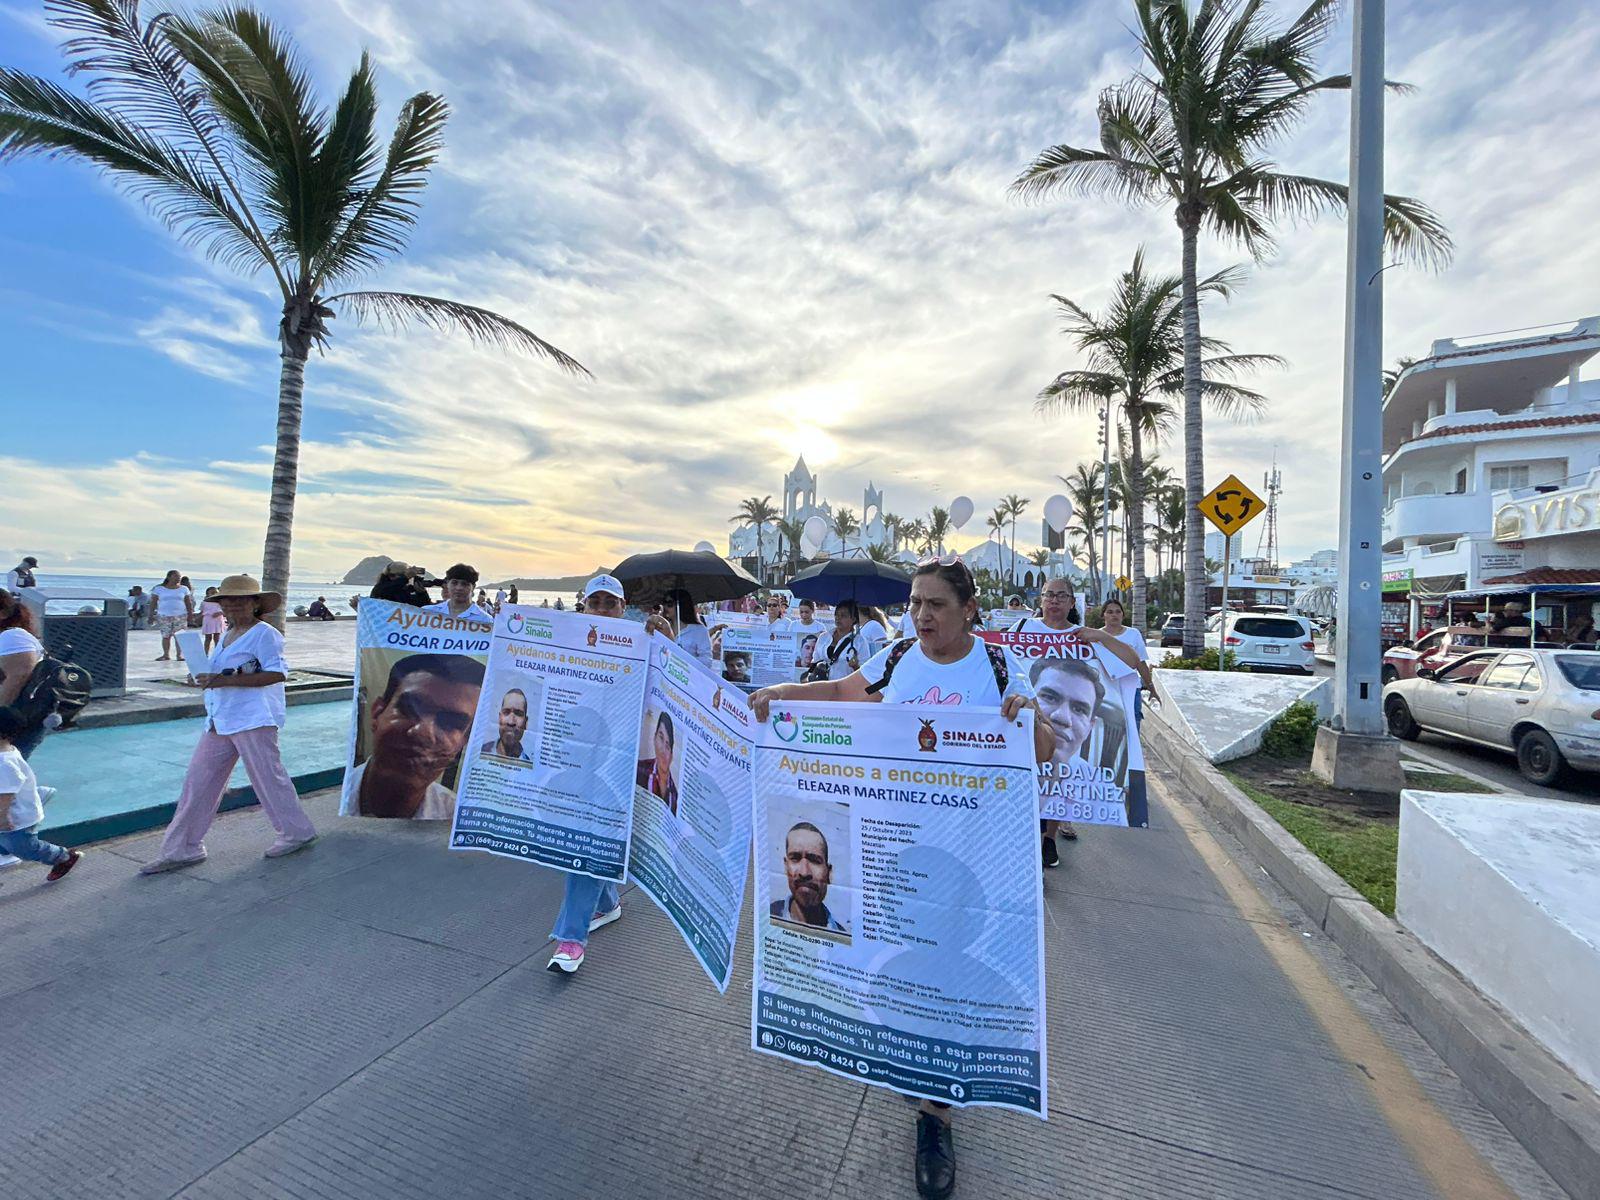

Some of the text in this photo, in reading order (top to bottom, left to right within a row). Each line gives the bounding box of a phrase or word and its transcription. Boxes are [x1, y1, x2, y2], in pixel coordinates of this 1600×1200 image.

[387, 607, 492, 633] Ayúdanos
[387, 632, 490, 651] OSCAR DAVID
[525, 626, 552, 639] Sinaloa
[600, 633, 633, 644] SINALOA
[1000, 633, 1082, 644] TE ESTAMO
[507, 643, 631, 673] Ayúdanos a encontrar a
[515, 660, 614, 684] ELEAZAR MARTINEZ CASAS
[721, 698, 748, 724] SINALOA
[802, 730, 852, 746] Sinaloa
[942, 730, 1006, 743] SINALOA
[779, 755, 1007, 790] Ayúdanos a encontrar a
[1059, 763, 1115, 783] DAVID
[797, 779, 978, 809] ELEAZAR MARTINEZ CASAS
[1038, 780, 1124, 802] MARTINEZ
[1045, 801, 1120, 821] 46 68 04
[460, 818, 480, 827] llama
[527, 830, 535, 838] Tu
[566, 841, 581, 850] muy
[472, 810, 494, 819] tienes
[537, 825, 565, 837] referente
[575, 834, 590, 842] esta
[592, 839, 622, 851] persona,
[861, 833, 887, 841] Municipio
[504, 843, 519, 851] 8424
[877, 850, 898, 858] Hombre
[762, 1008, 789, 1024] llama
[791, 1018, 797, 1026] o
[862, 1038, 875, 1050] Tu
[878, 1044, 912, 1061] ayuda
[915, 1055, 929, 1064] es
[932, 1057, 959, 1072] muy
[962, 1063, 1034, 1078] importante.
[777, 1000, 806, 1017] tienes
[811, 1007, 872, 1037] información
[877, 1030, 928, 1051] referente
[934, 1045, 941, 1053] a
[946, 1047, 972, 1060] esta
[978, 1051, 1033, 1065] persona,
[787, 1040, 854, 1069] (669) 327 8424
